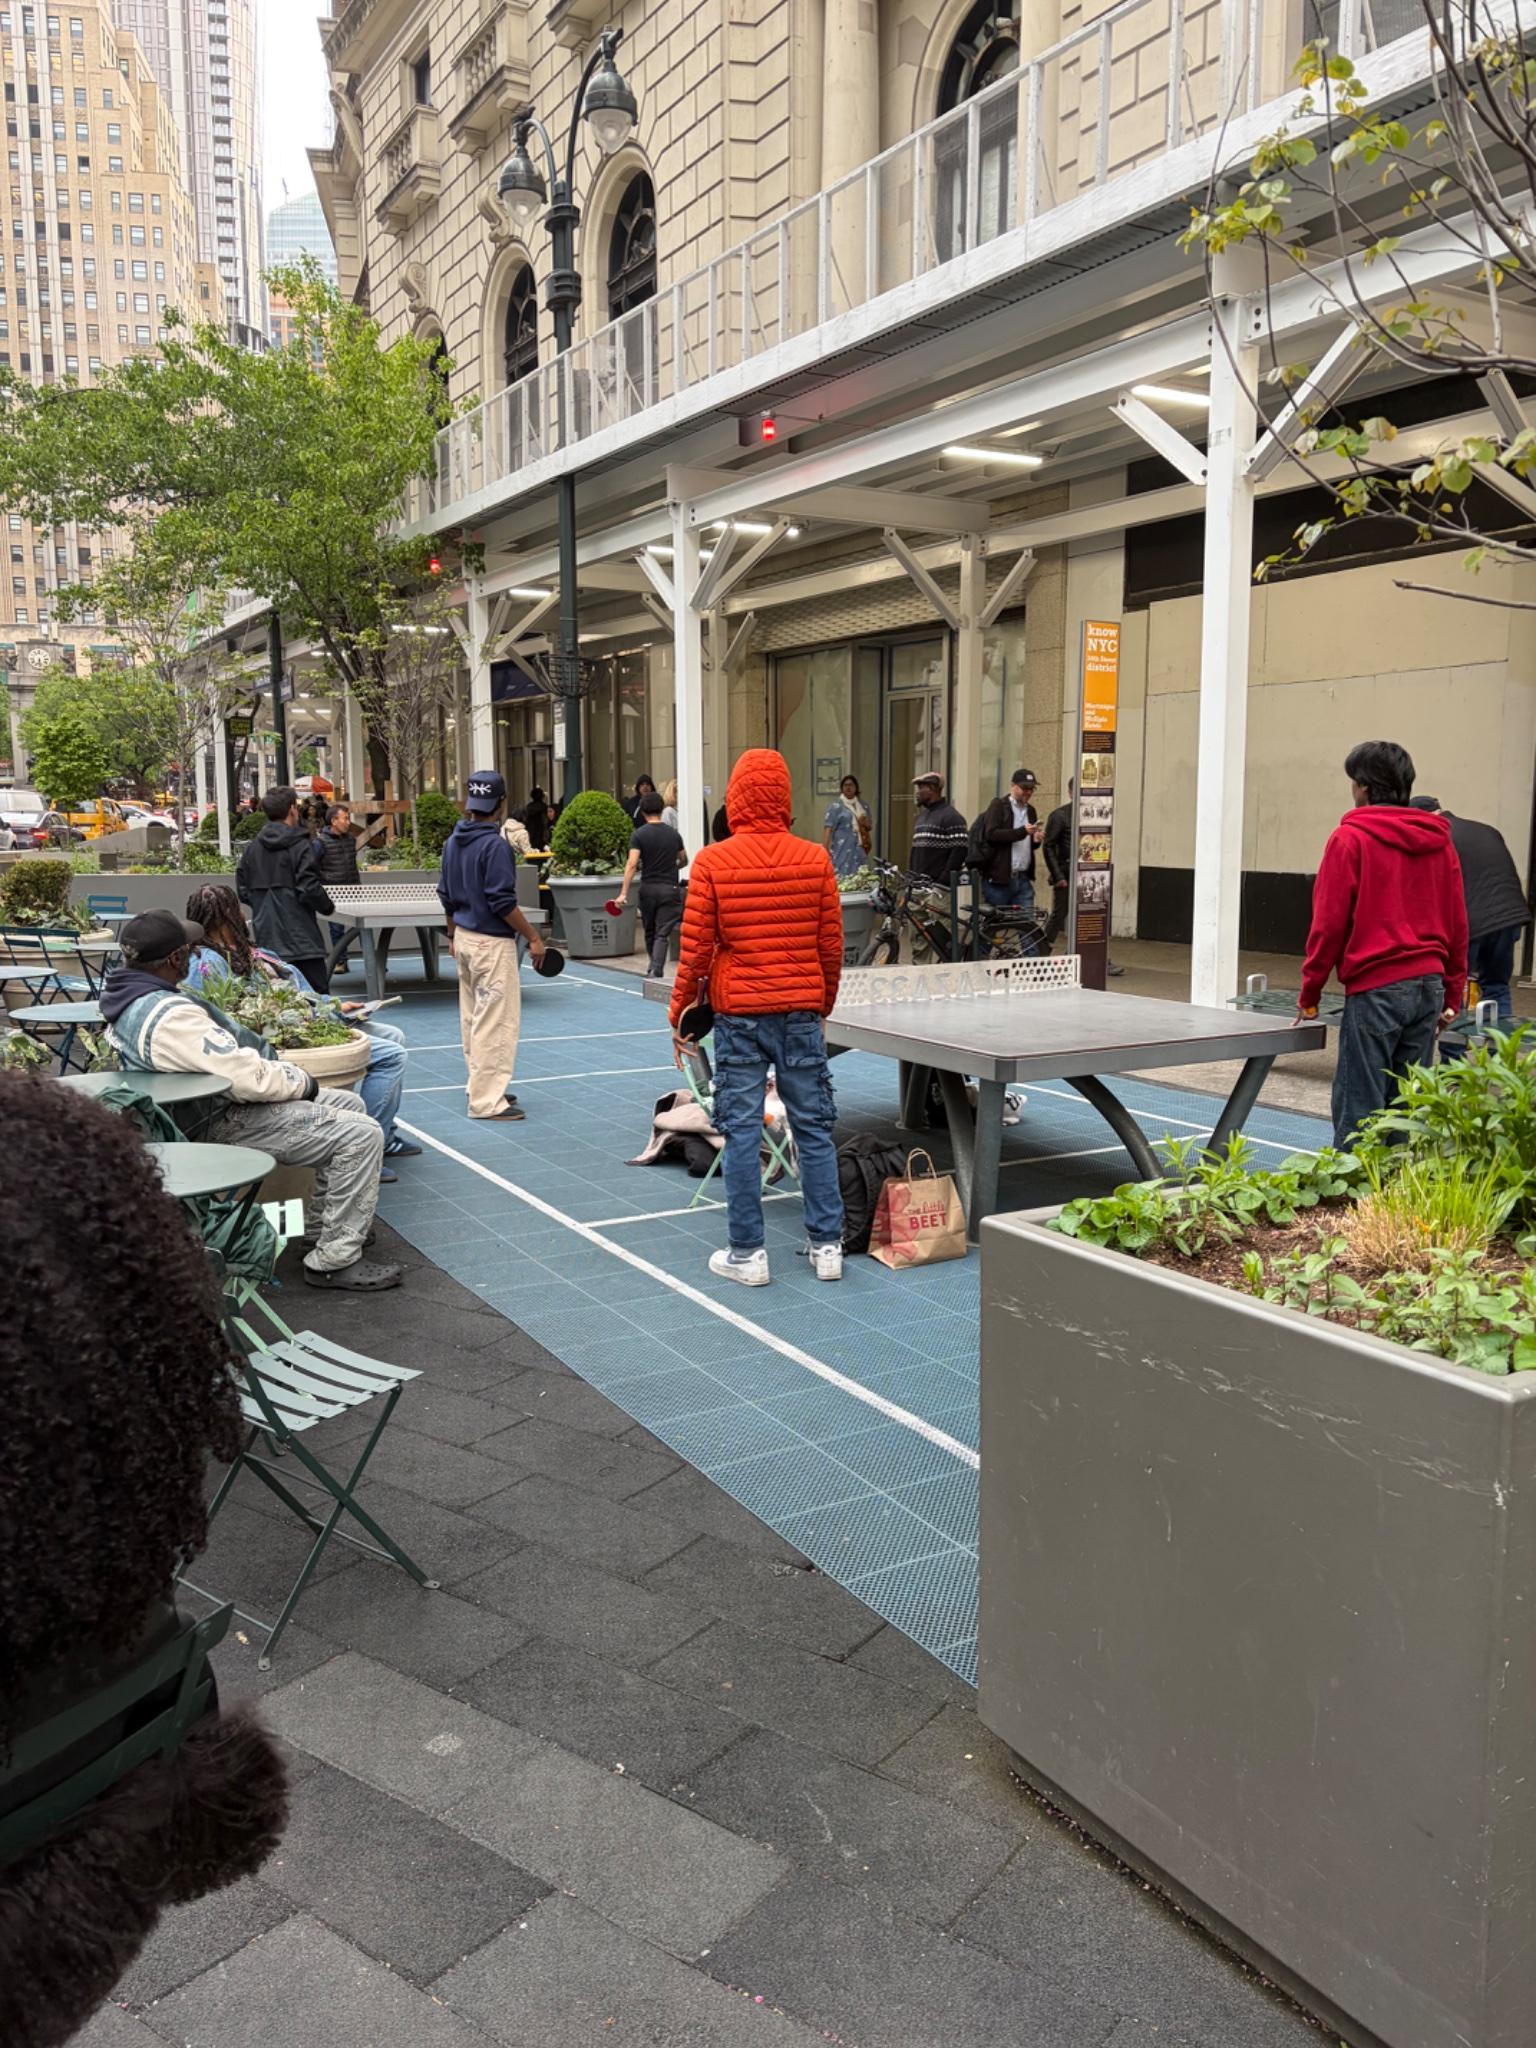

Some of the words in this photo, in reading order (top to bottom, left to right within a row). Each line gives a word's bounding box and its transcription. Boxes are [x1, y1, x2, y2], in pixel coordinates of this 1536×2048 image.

[1087, 623, 1118, 638] know
[1087, 638, 1118, 653] NYC
[1087, 662, 1117, 672] district
[909, 1212, 947, 1230] BEET
